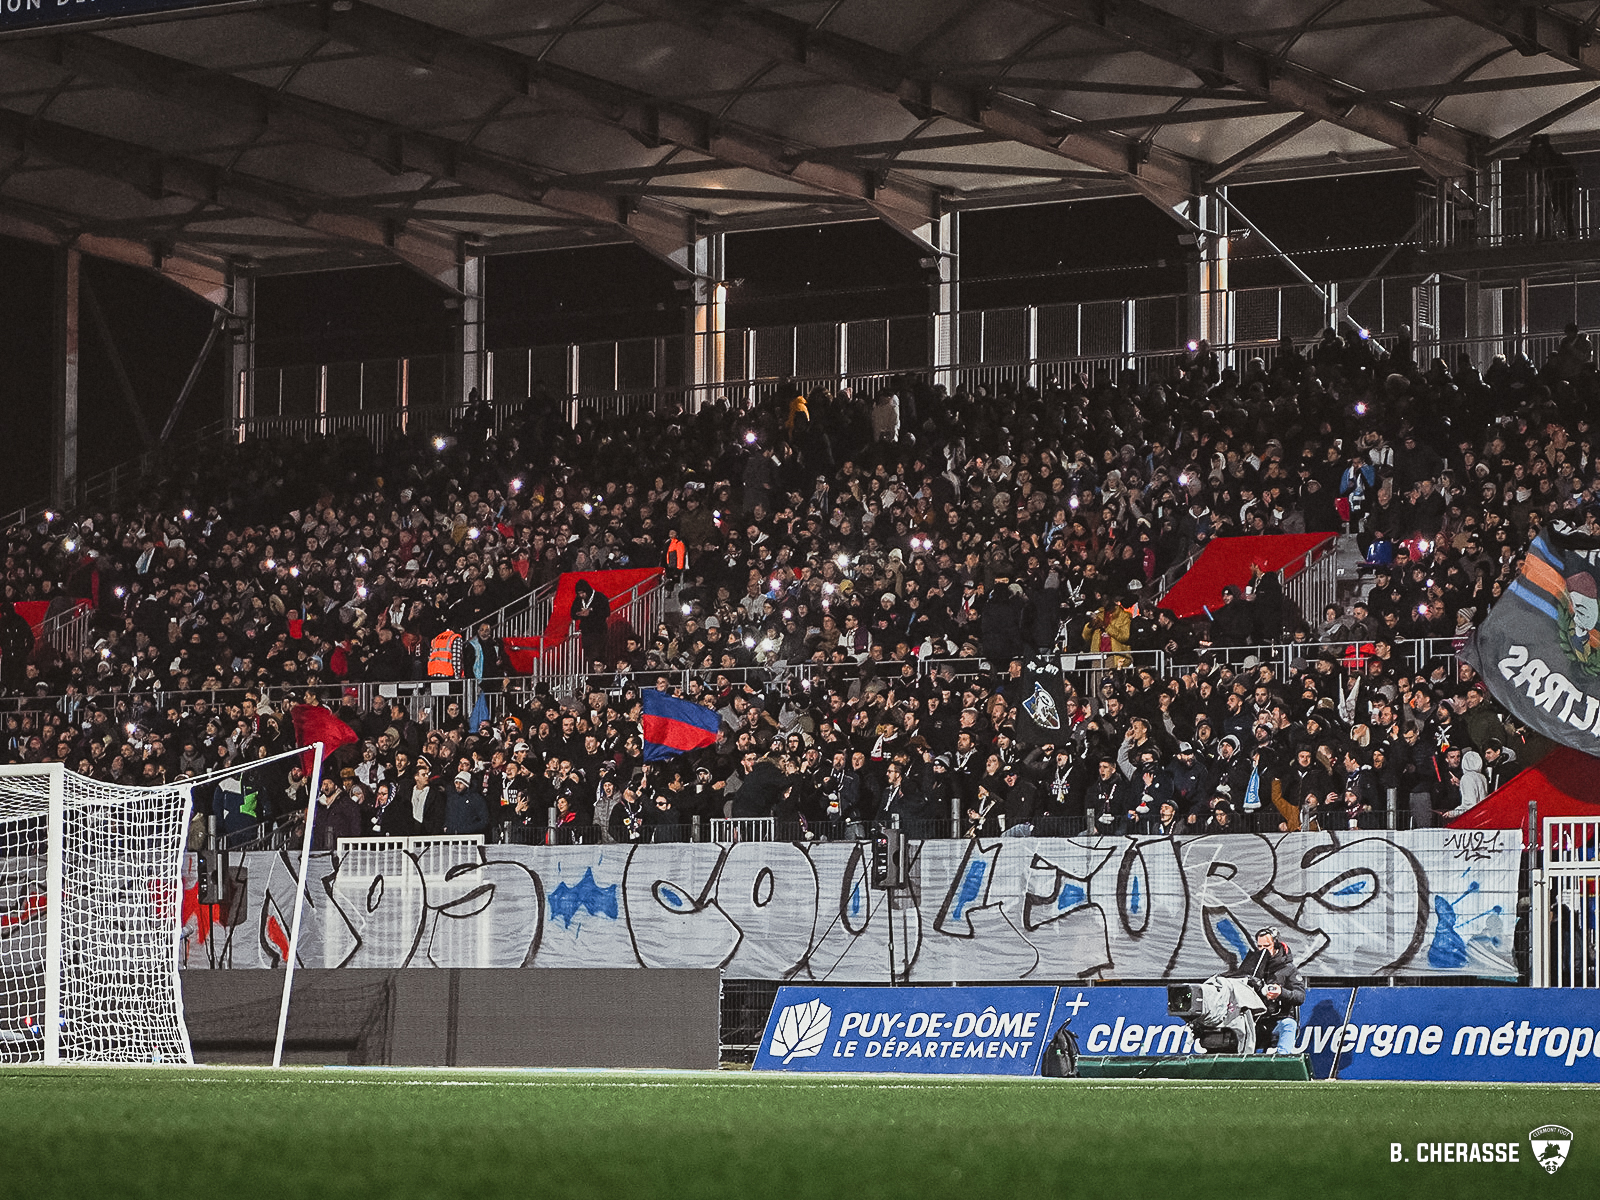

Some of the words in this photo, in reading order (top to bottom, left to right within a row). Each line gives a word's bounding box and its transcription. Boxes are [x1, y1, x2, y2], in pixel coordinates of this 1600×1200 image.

[622, 830, 1430, 980] COULEURS
[832, 1040, 858, 1058] LE
[864, 1036, 1035, 1059] DÉPARTEMENT
[1086, 1016, 1208, 1055] clerm
[1266, 1022, 1443, 1058] uvergne
[1451, 1020, 1600, 1067] métrop
